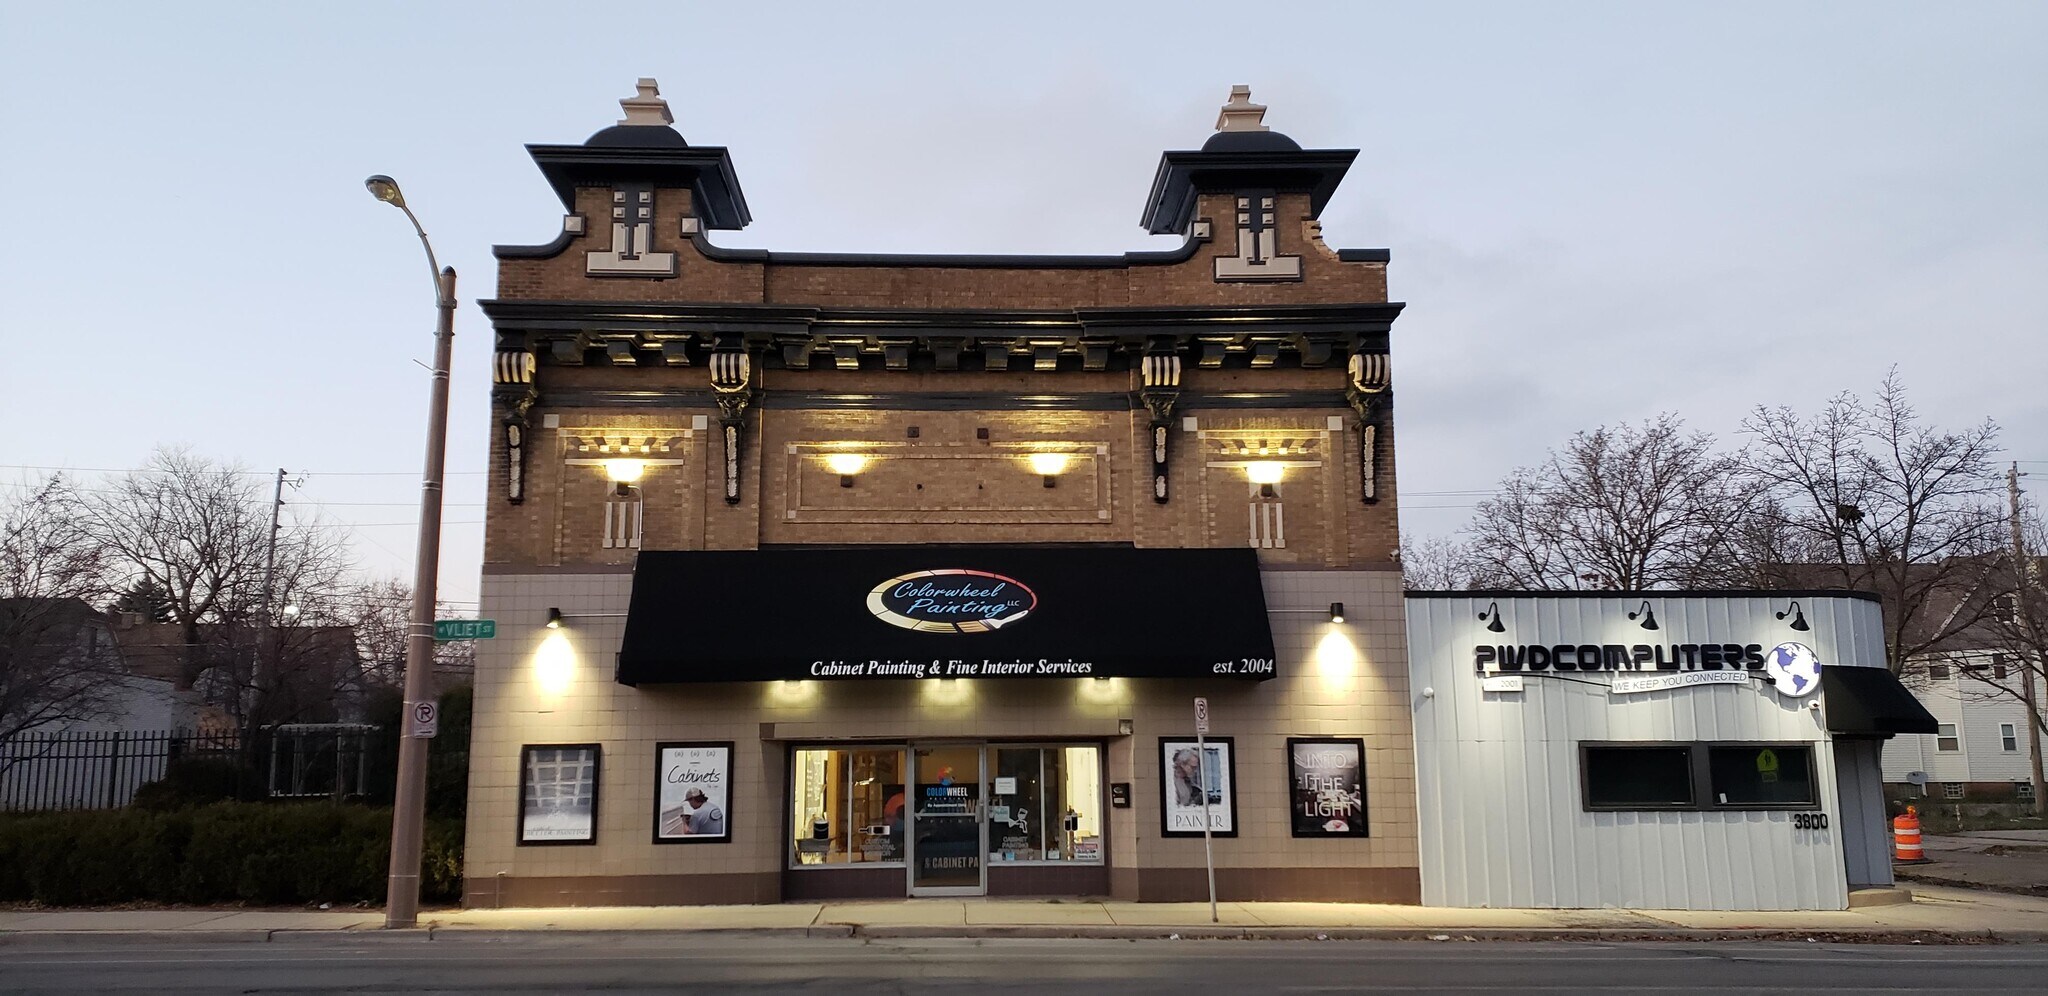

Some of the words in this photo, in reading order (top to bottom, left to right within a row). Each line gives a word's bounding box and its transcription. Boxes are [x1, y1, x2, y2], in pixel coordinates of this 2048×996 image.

[893, 582, 1006, 598] Colorwheel
[906, 598, 1009, 618] Painting
[445, 623, 482, 636] VLIET
[482, 625, 492, 633] ST
[810, 660, 864, 676] Cabinet
[866, 660, 925, 678] Painting
[929, 659, 941, 675] &
[946, 659, 978, 675] Fine
[980, 659, 1034, 675] Interior
[1036, 659, 1092, 674] Services
[1213, 660, 1236, 674] est.
[1240, 658, 1273, 674] 2004
[1614, 682, 1630, 691] WE
[1632, 679, 1659, 690] KEEP
[1662, 676, 1683, 687] YOU
[1685, 672, 1747, 684] CONNECTED
[1307, 752, 1347, 769] INTO
[667, 764, 721, 784] Cabinets
[926, 786, 969, 797] COLORWHEEL
[1309, 777, 1343, 792] THE
[1304, 801, 1354, 817] LIGHT
[1175, 814, 1224, 828] PAINER
[1793, 813, 1829, 830] 3800
[932, 856, 967, 869] CABINET
